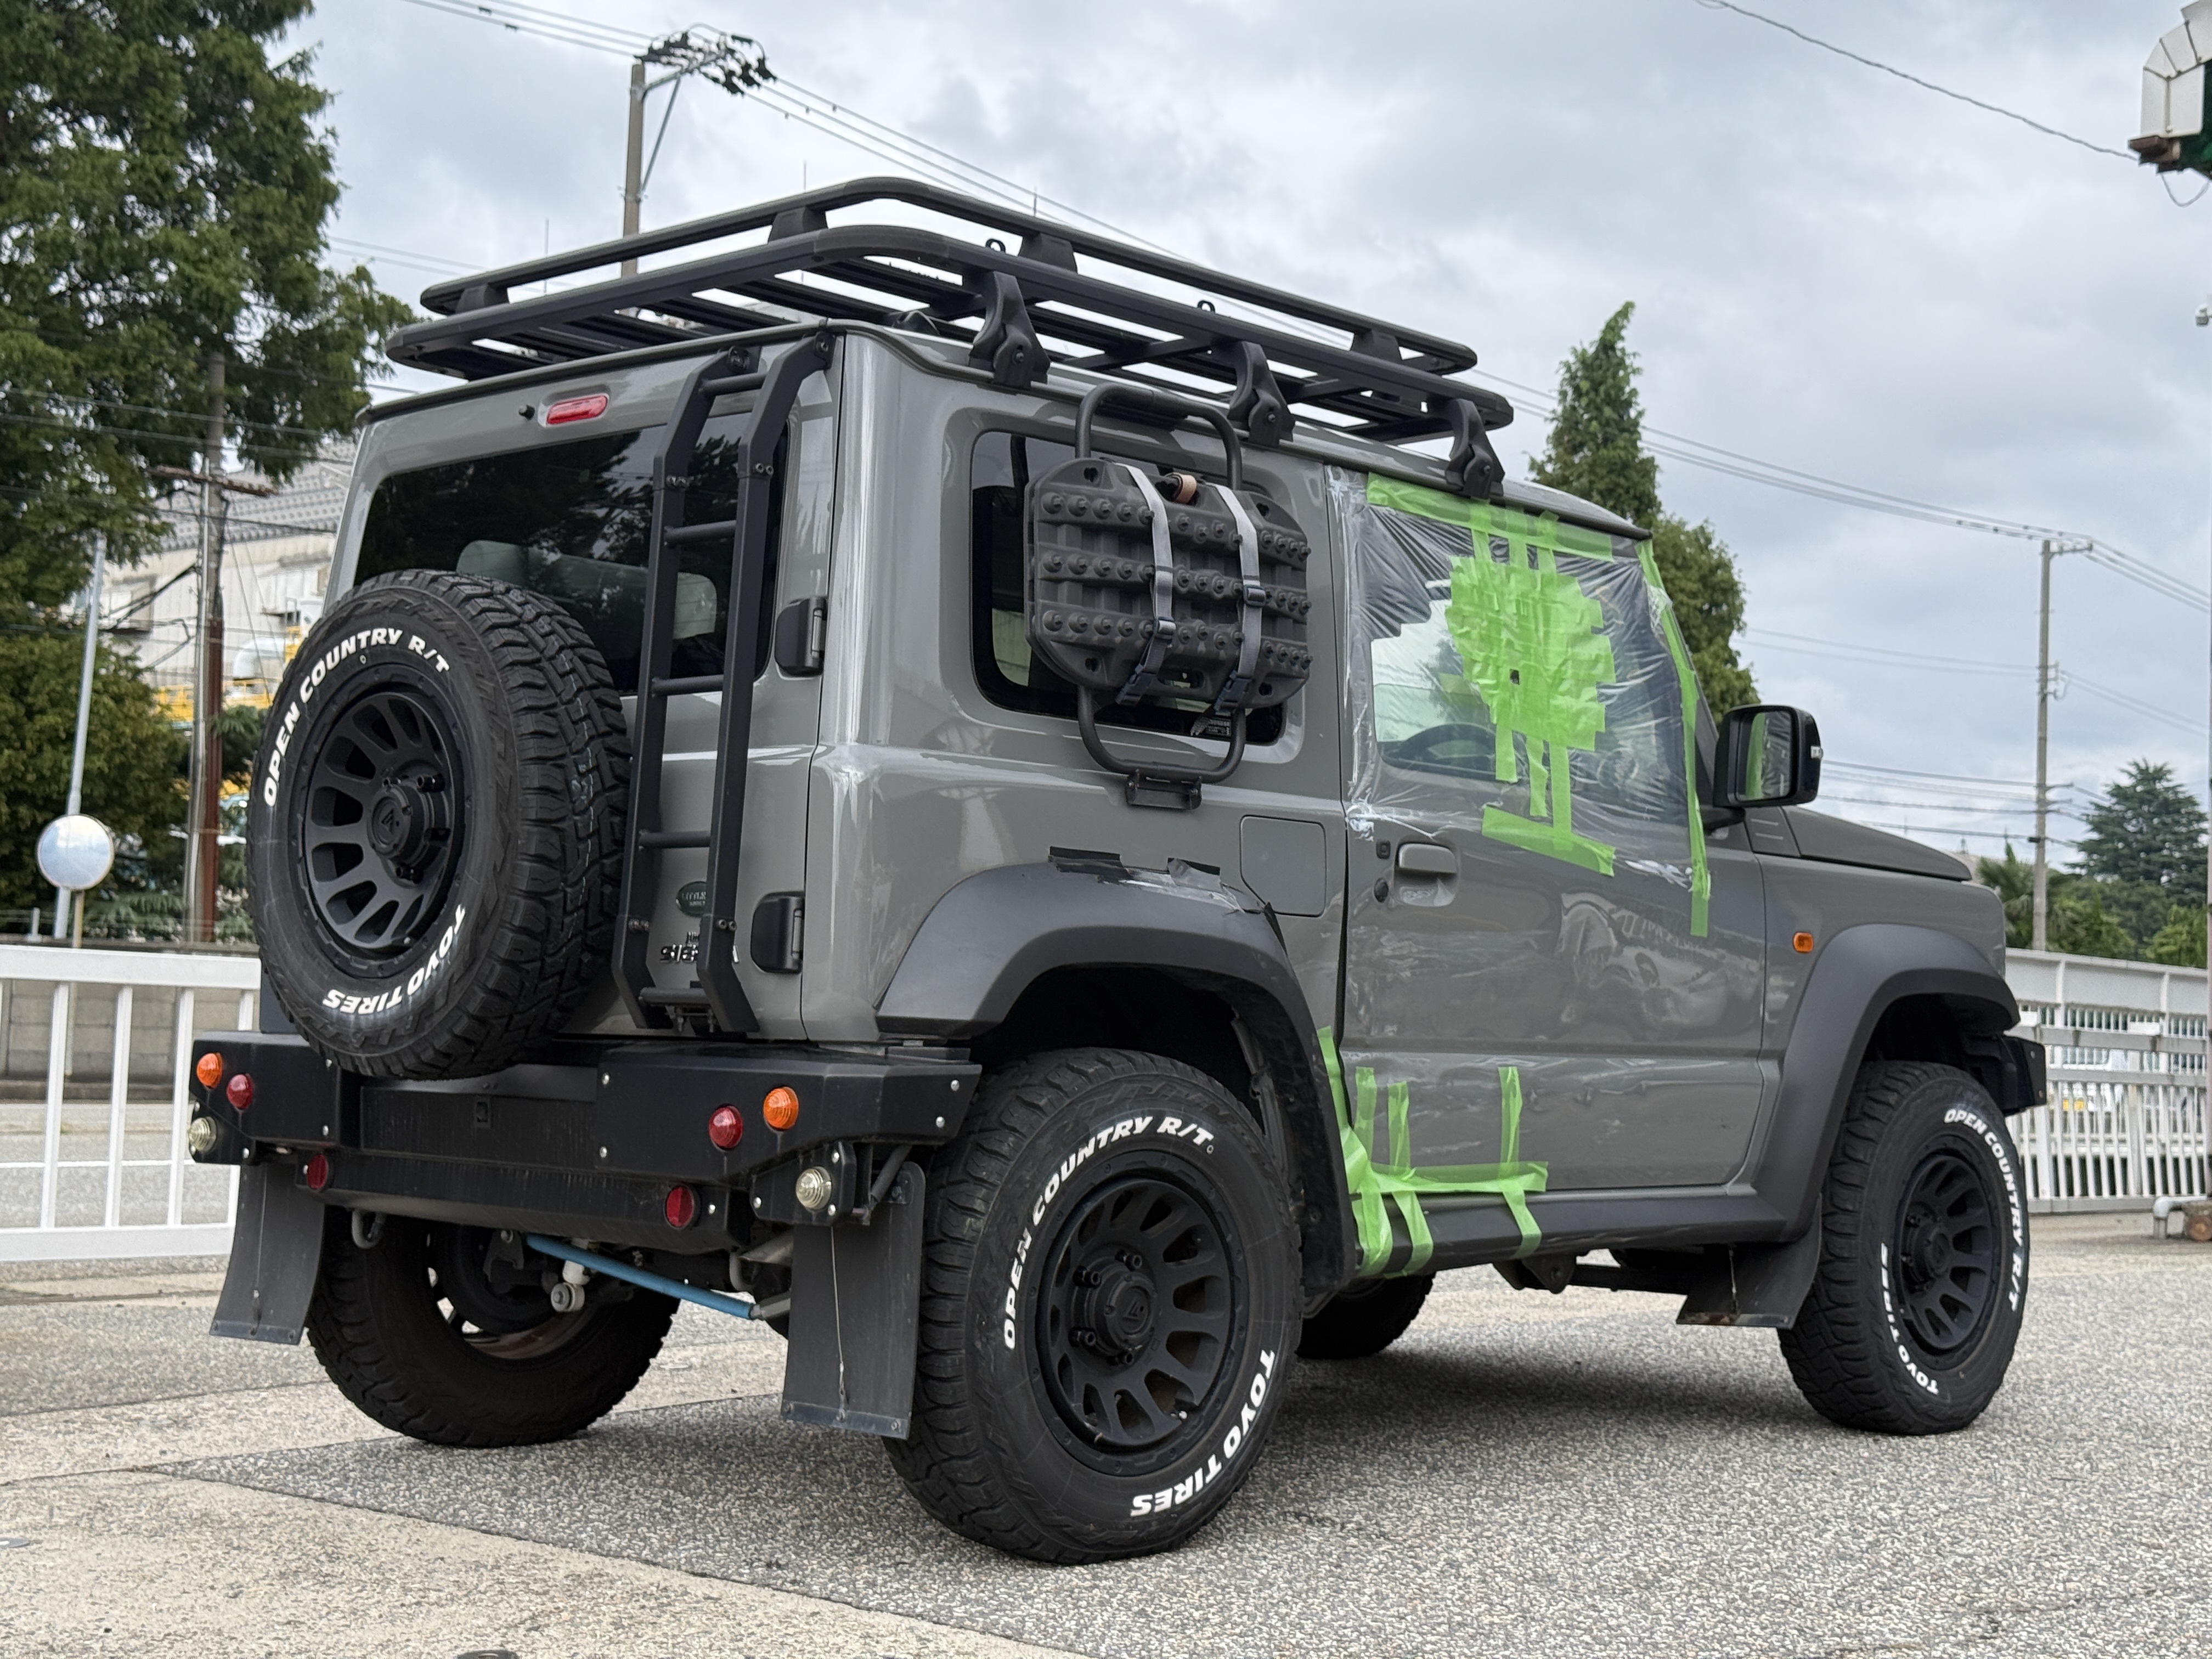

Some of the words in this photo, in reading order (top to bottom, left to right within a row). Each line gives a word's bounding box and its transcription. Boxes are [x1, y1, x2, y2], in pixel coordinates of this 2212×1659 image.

[264, 703, 301, 808] OPEN
[300, 627, 403, 704] COUNTRY
[407, 635, 450, 673] R/T
[407, 903, 466, 996] TOYO
[321, 988, 404, 1017] TIRES
[1003, 1228, 1032, 1350] OPEN
[1032, 1115, 1154, 1227] COUNTRY
[1156, 1116, 1215, 1147] R/T
[1944, 1108, 1988, 1135] OPEN
[1984, 1131, 2024, 1247] COUNTRY
[2008, 1251, 2024, 1312] R/T
[1881, 1243, 1900, 1343] TIRES
[1223, 1349, 1276, 1459] TOYO
[1898, 1344, 1939, 1395] TOYO
[1130, 1454, 1223, 1517] TIRES
